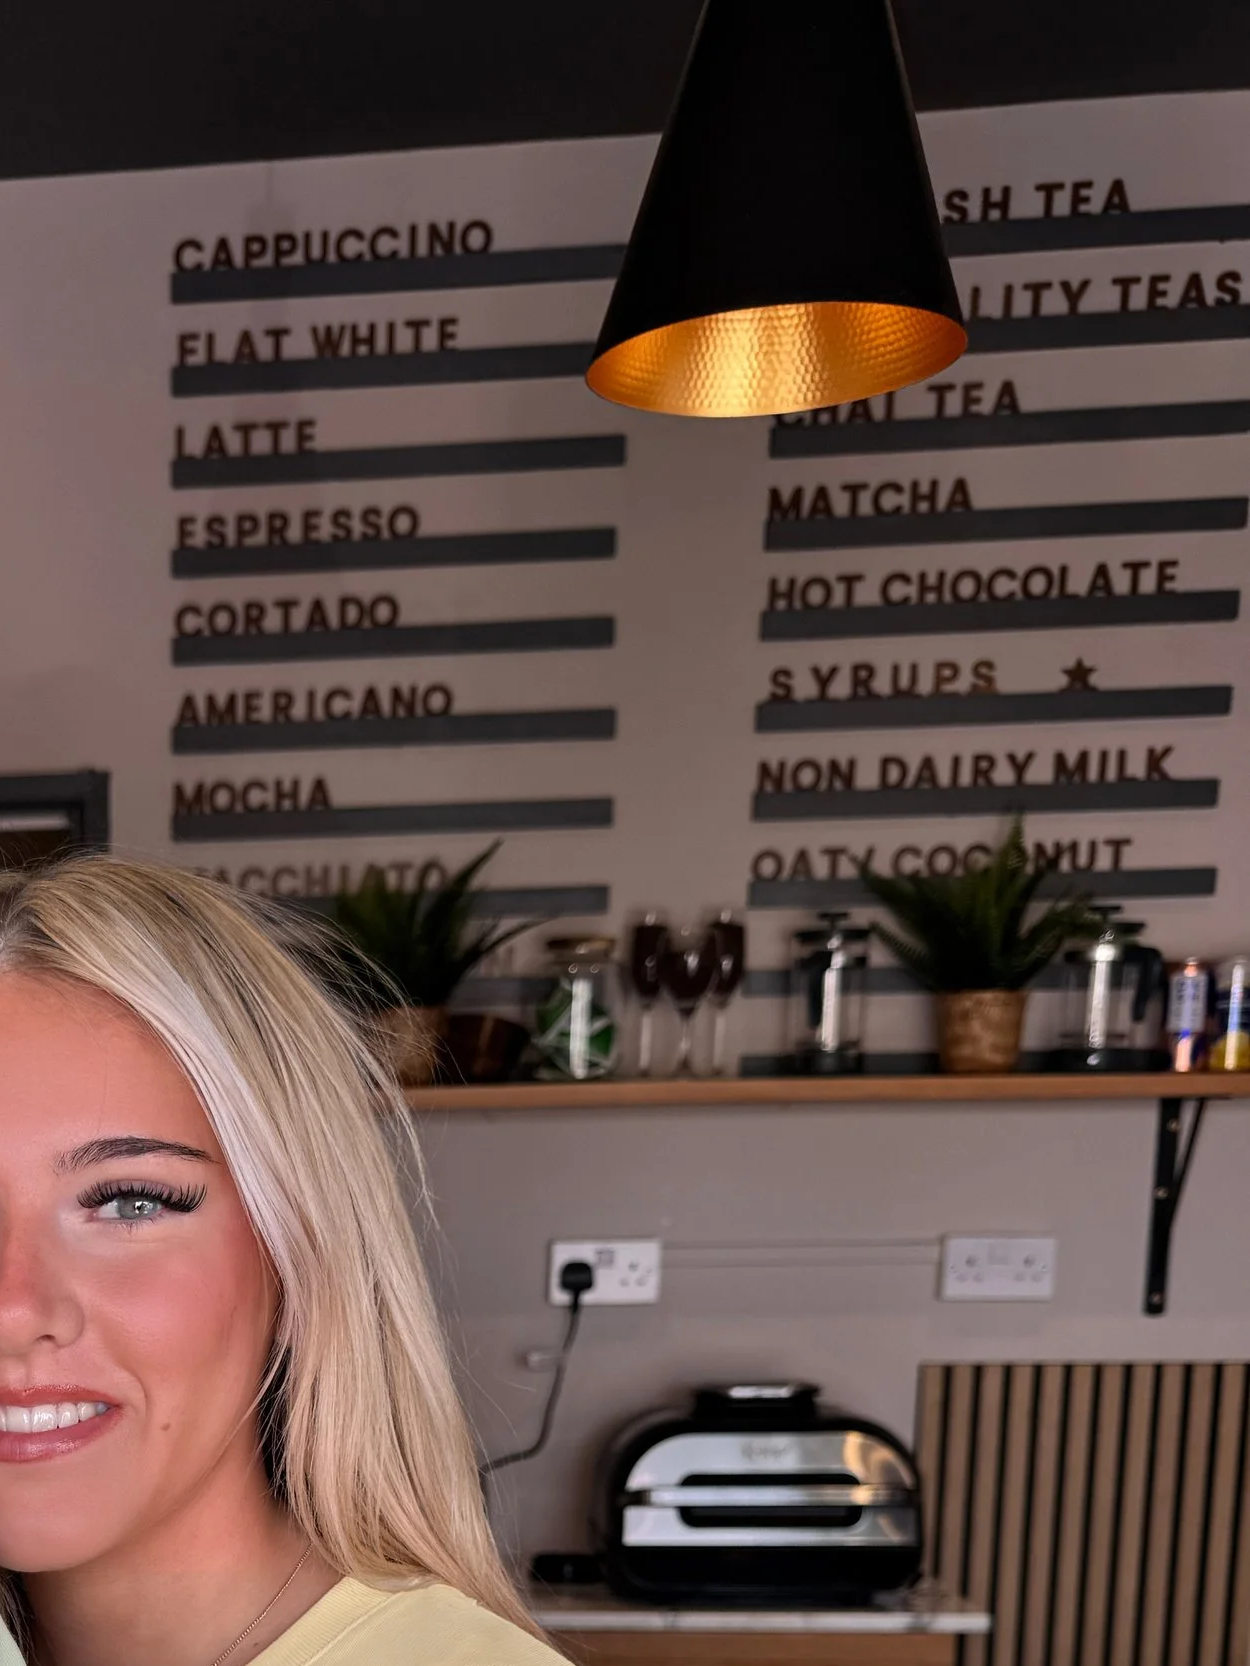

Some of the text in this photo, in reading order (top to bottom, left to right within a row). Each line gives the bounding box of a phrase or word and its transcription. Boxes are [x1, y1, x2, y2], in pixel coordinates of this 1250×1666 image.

[1034, 178, 1132, 219] TEA
[174, 219, 493, 273] CAPPUCCINO
[1112, 270, 1242, 313] TEAS
[177, 317, 460, 368] FLAT WHITE
[926, 380, 1021, 420] TEA
[174, 419, 317, 460] LATTE
[767, 477, 975, 521] MATCHA
[177, 505, 421, 550] ESPRESSO
[767, 559, 1179, 612] HOT CHOCOLATE
[173, 593, 400, 638] CORTADO
[768, 659, 1000, 702] SYRUPS
[175, 682, 454, 727] AMERICANO
[756, 745, 1176, 794] NON DAIRY MILK
[171, 775, 335, 816] MOCHA
[890, 837, 1133, 882] COCNUT
